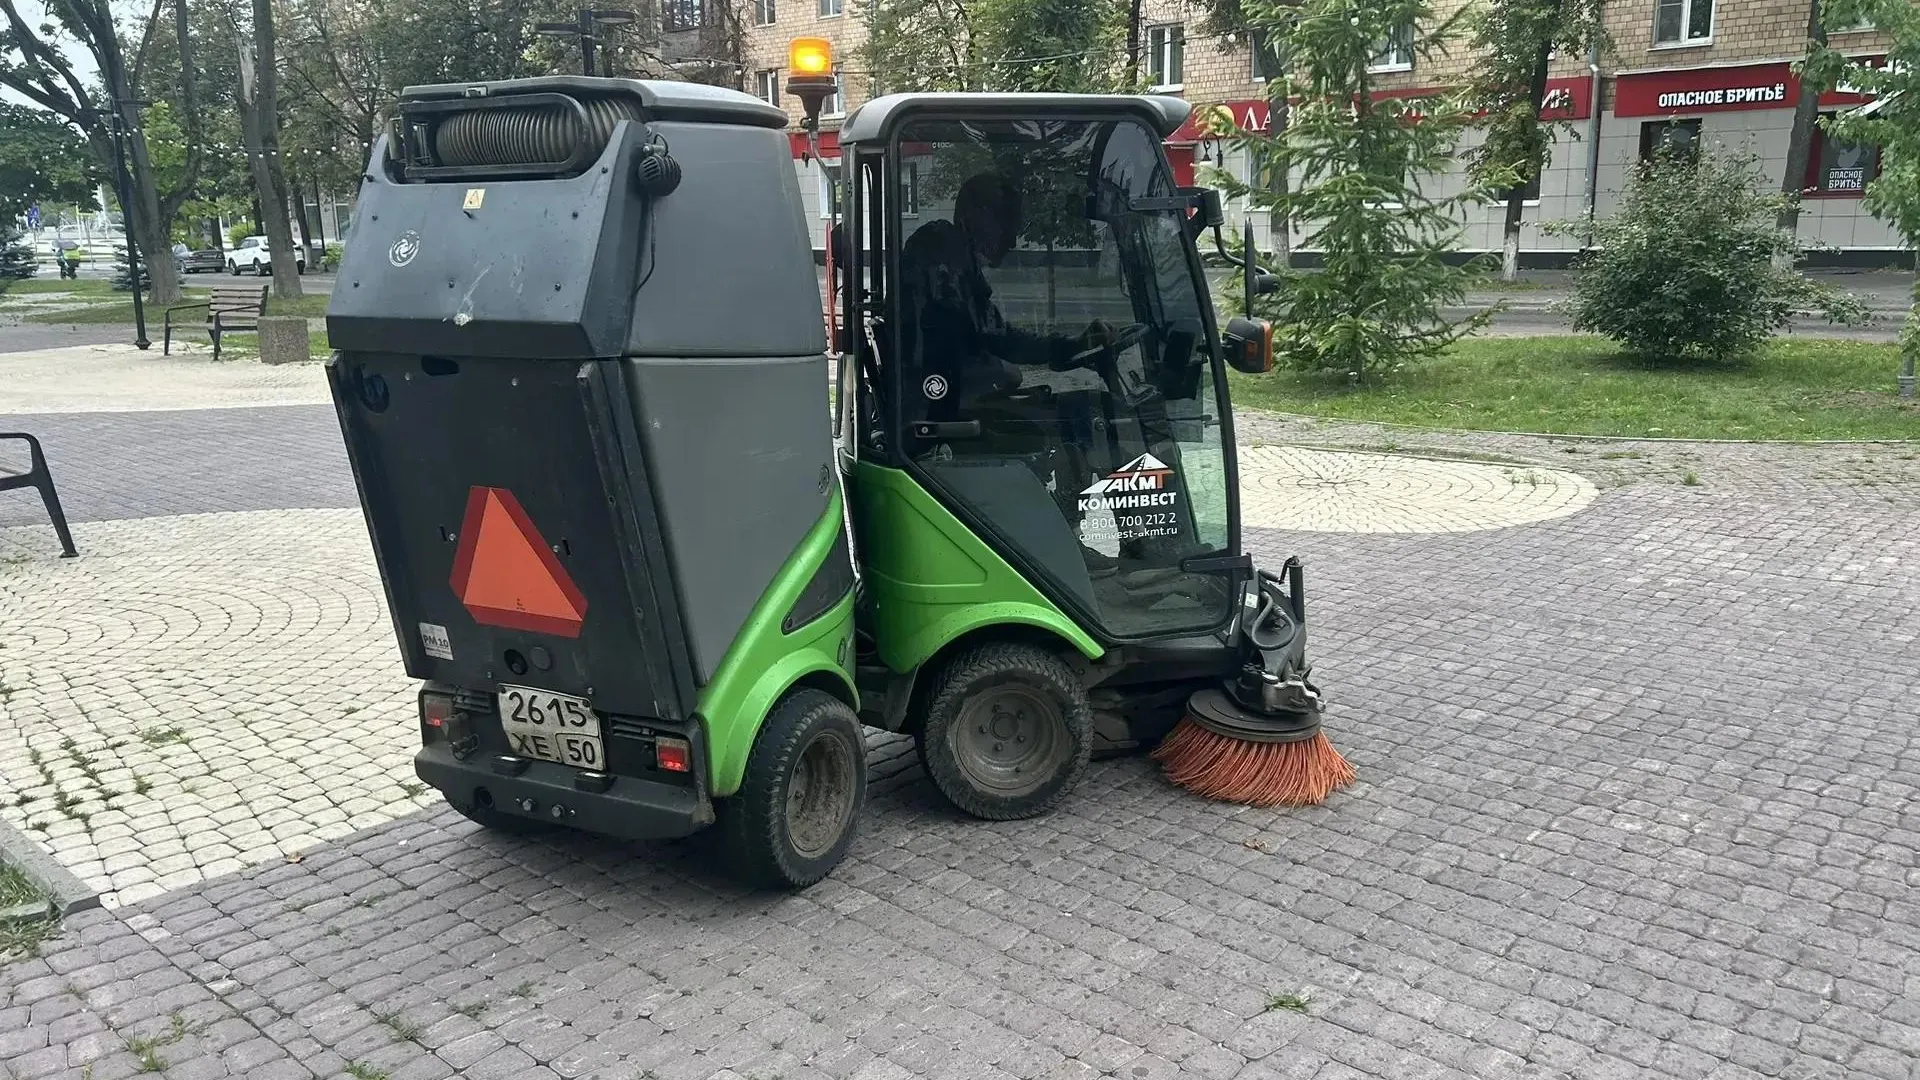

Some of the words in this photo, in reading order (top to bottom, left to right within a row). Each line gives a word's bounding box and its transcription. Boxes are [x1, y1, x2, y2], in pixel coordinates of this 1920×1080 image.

[1658, 89, 1723, 107] ОПАСНОЕ
[1725, 83, 1785, 103] БРИТЬЁ
[1828, 177, 1862, 189] БРИТЬЁ
[1829, 170, 1863, 179] ОПАСНОЕ
[1078, 492, 1176, 511] КОМИНВЕСТ
[1080, 519, 1088, 530] 8
[1092, 517, 1116, 529] 800
[1119, 515, 1142, 527] 700
[1145, 513, 1166, 525] 212
[1169, 512, 1176, 523] 2
[1079, 526, 1178, 541] cominvest-akmt.ru
[509, 692, 587, 727] 2615
[566, 739, 596, 765] 50
